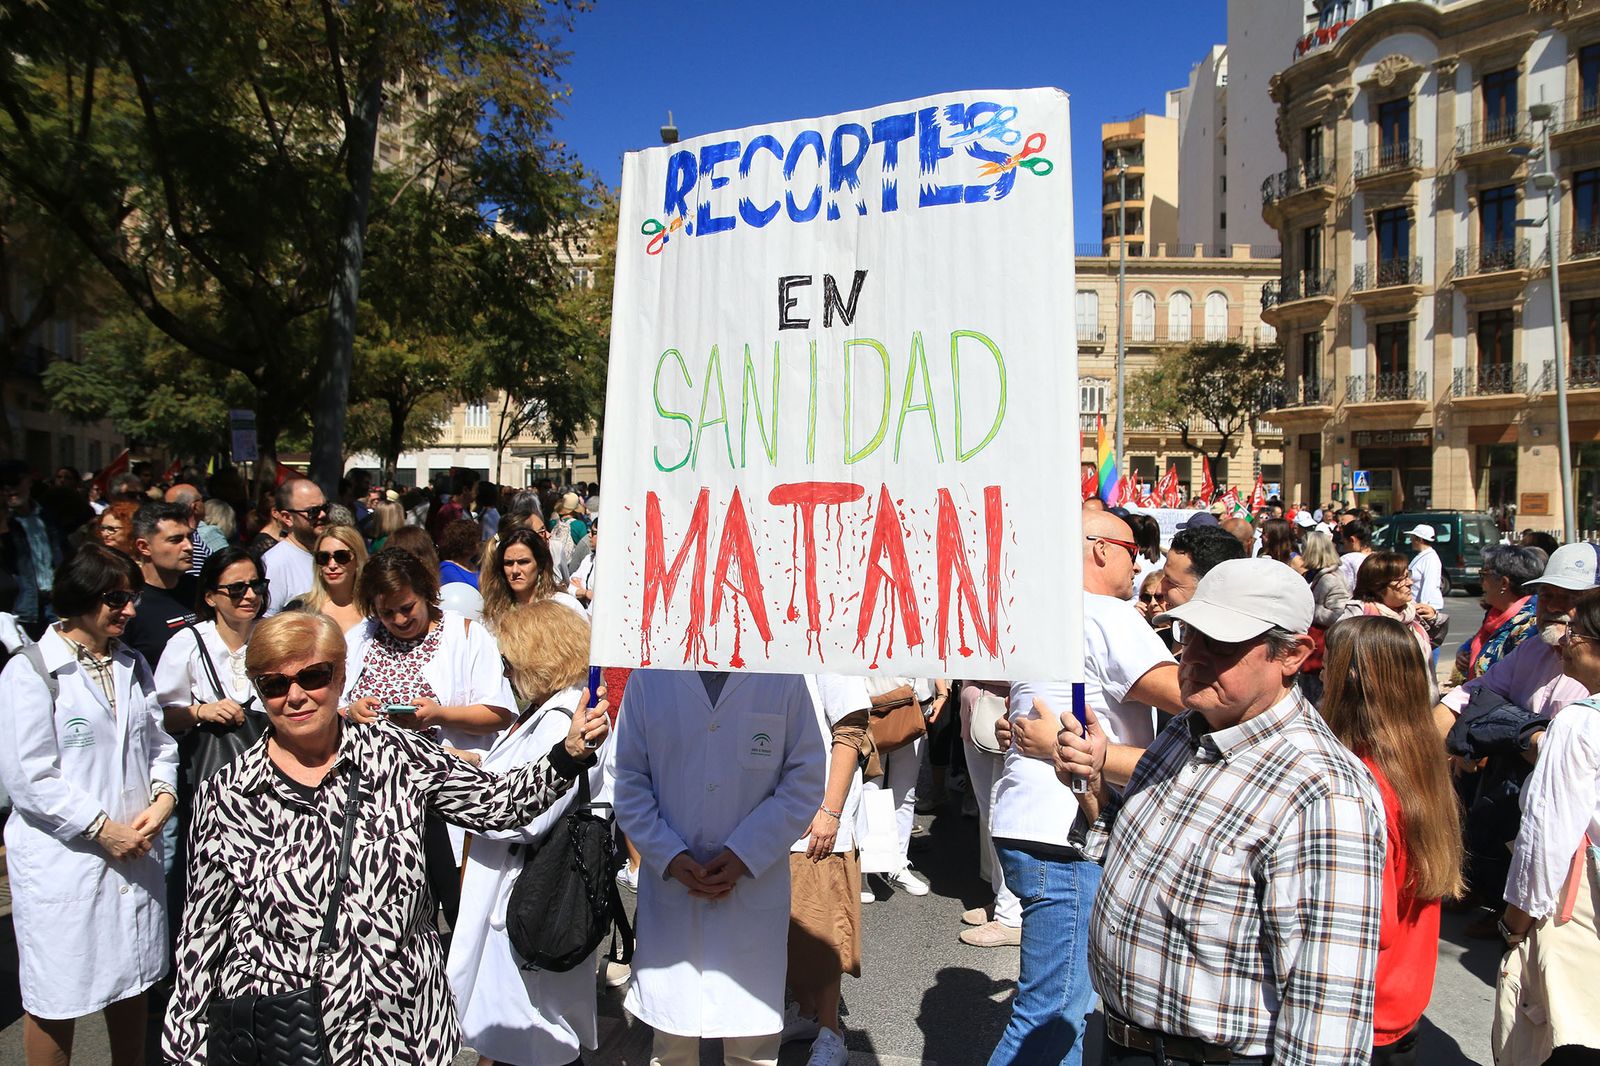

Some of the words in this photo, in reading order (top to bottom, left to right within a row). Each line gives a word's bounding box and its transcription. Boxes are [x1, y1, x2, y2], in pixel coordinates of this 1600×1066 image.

[663, 101, 1017, 243] RECORTES
[778, 269, 869, 331] EN
[653, 329, 1007, 472] SANIDAD
[640, 481, 1002, 664] MATAN
